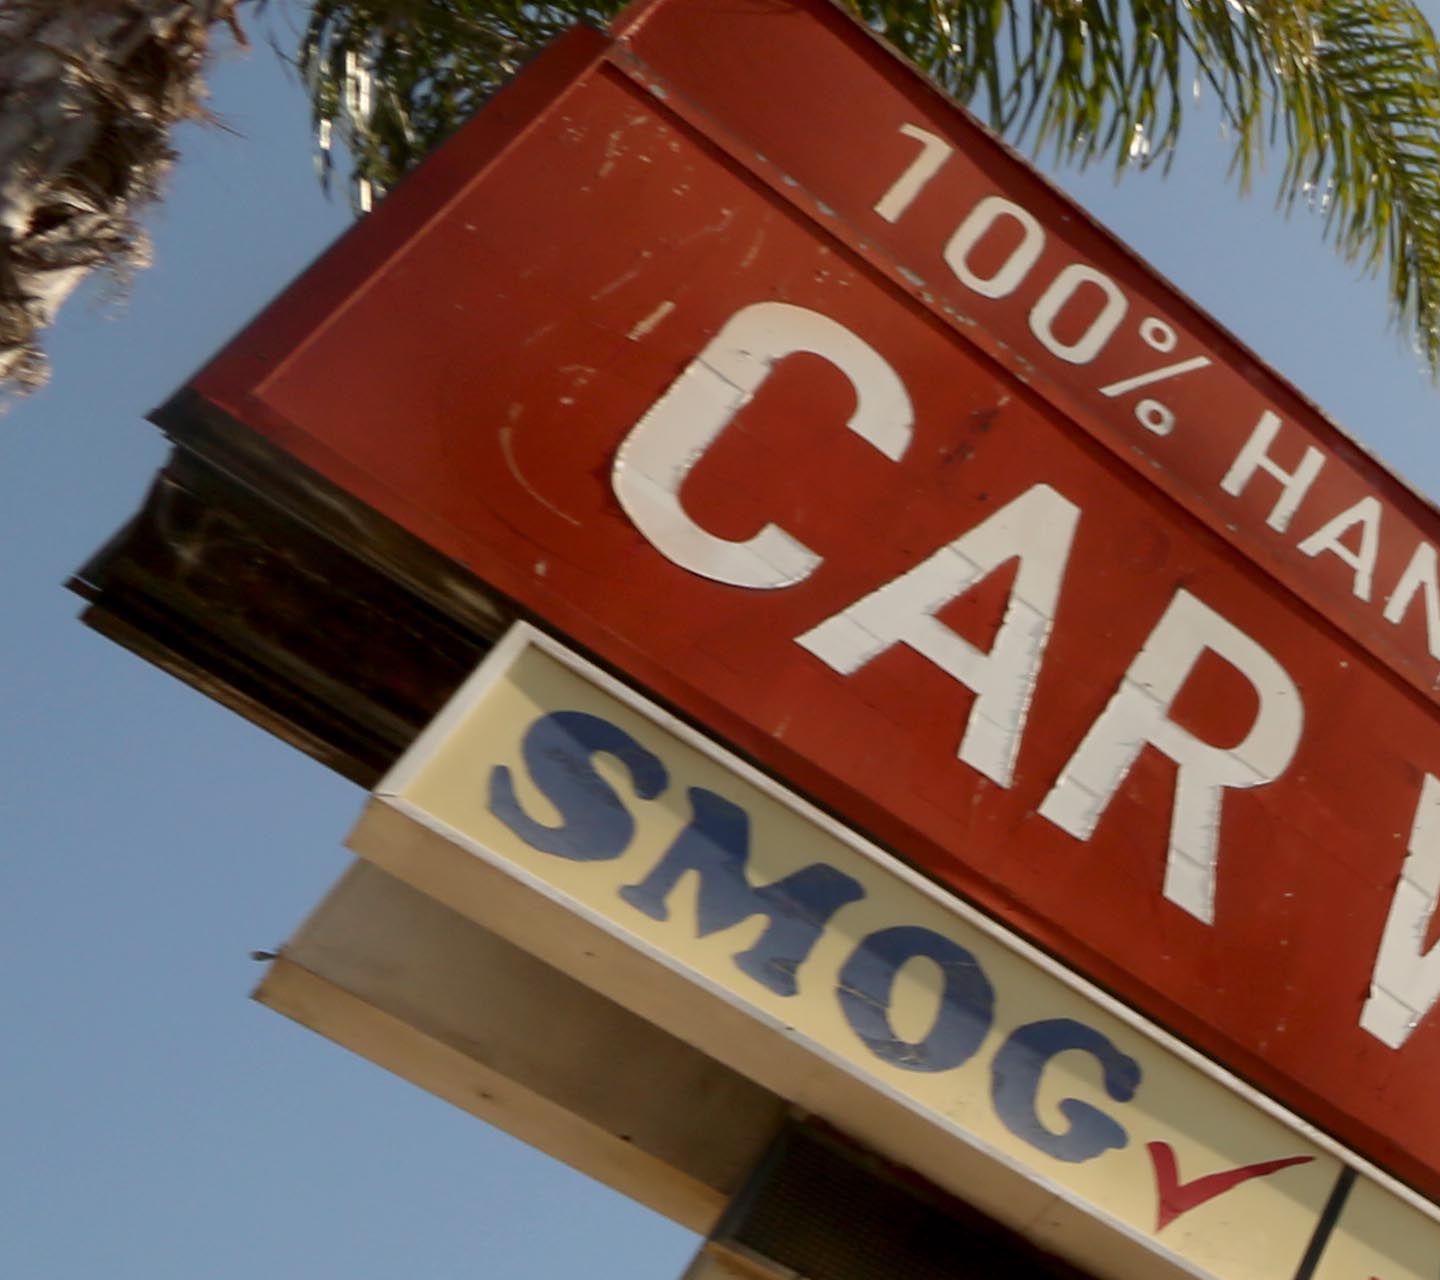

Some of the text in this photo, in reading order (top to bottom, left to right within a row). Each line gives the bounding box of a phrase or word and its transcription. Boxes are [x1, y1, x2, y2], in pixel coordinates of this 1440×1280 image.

[874, 123, 1212, 437] 100%
[611, 301, 1304, 925] CAR
[487, 709, 1142, 1163] SMOG
